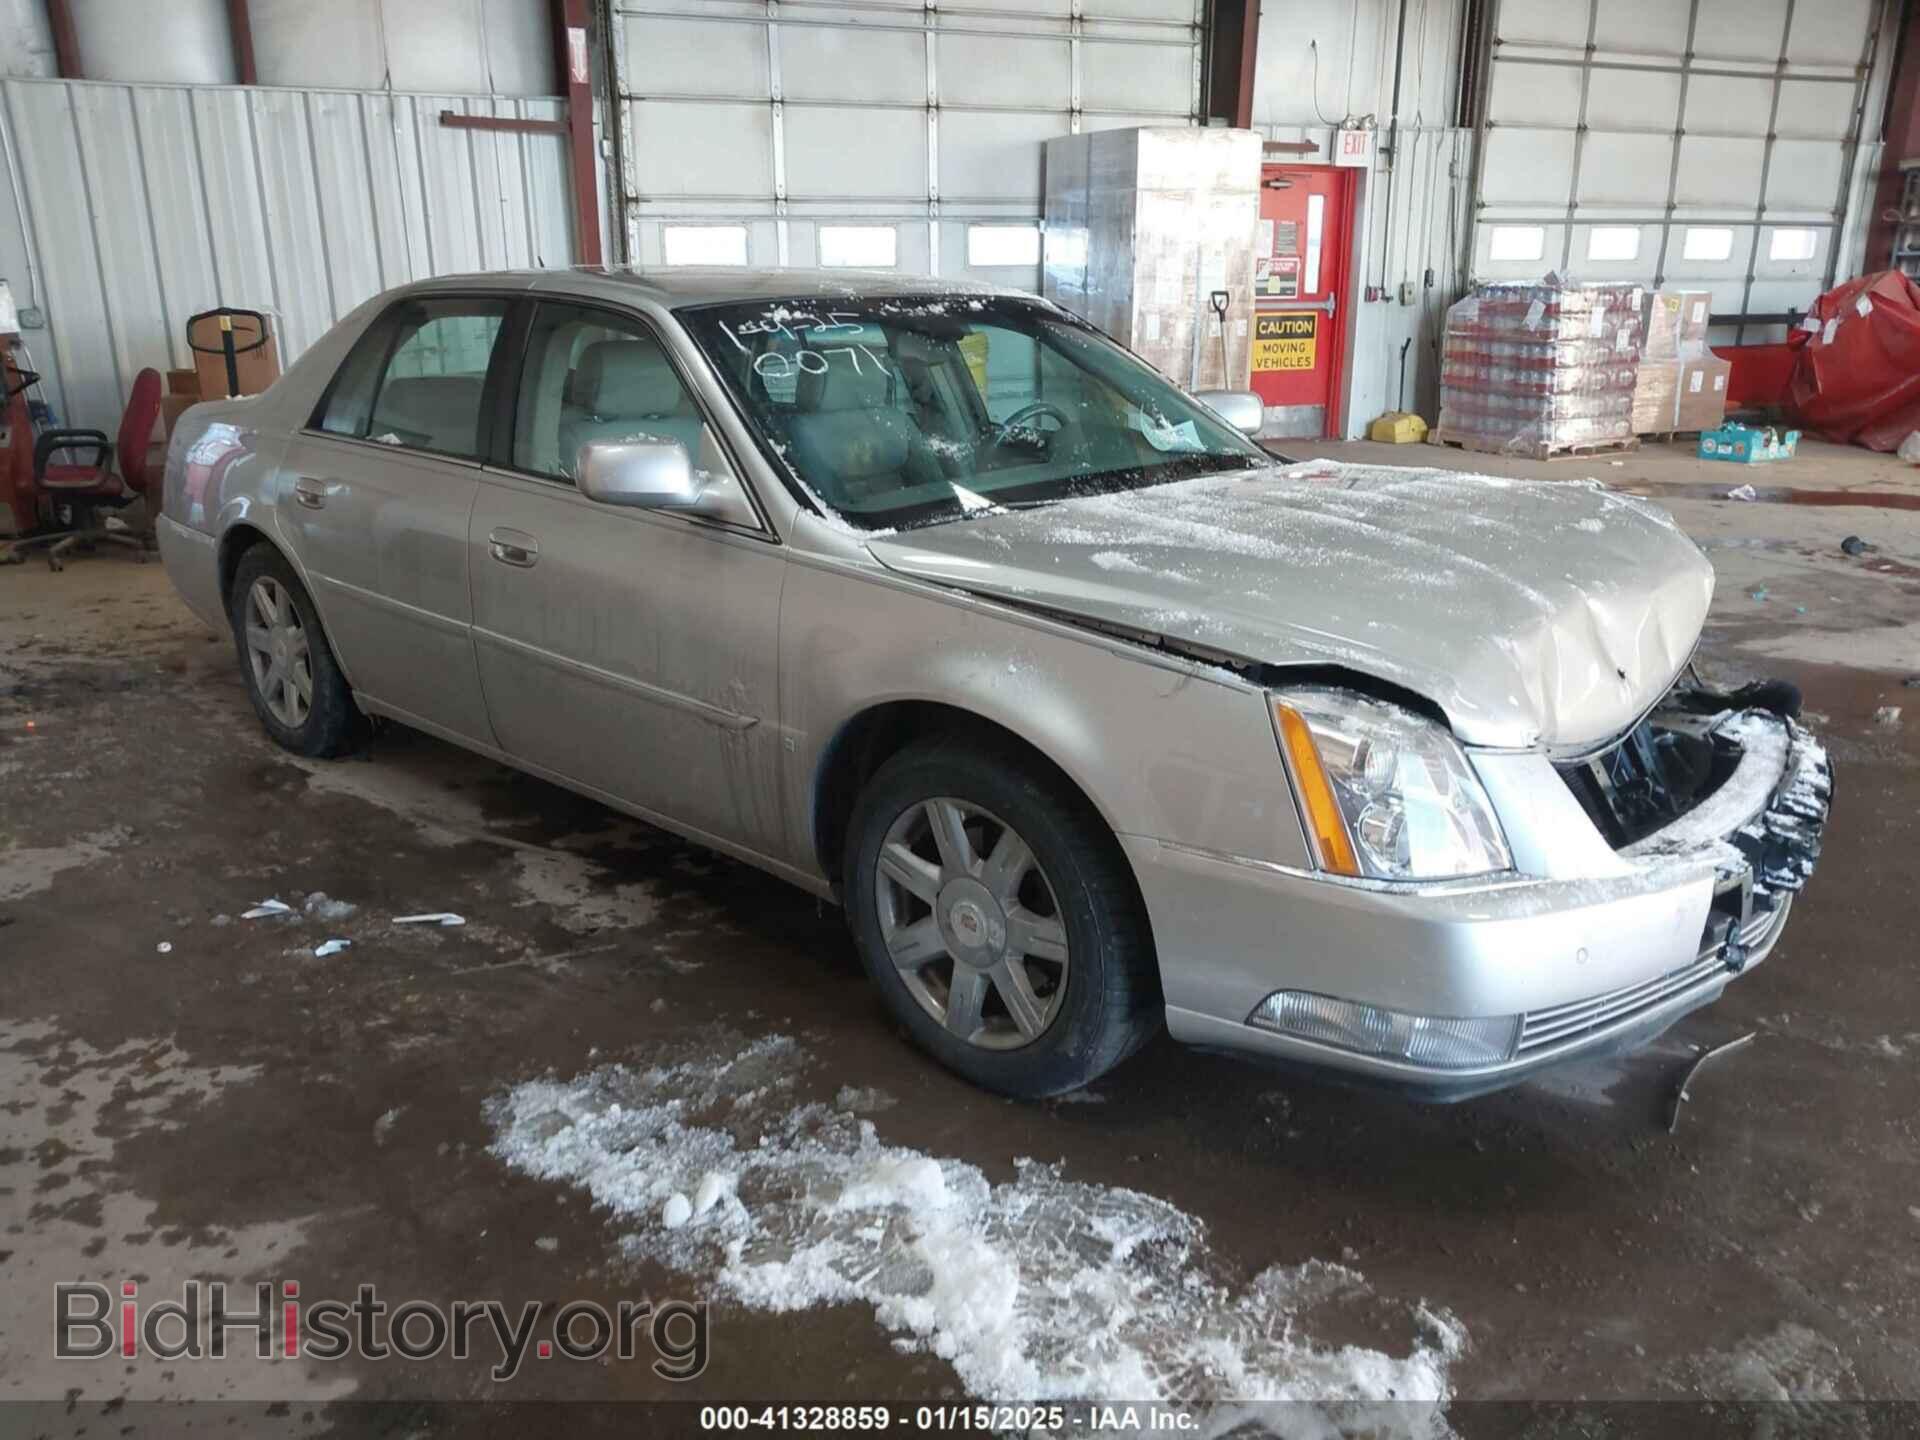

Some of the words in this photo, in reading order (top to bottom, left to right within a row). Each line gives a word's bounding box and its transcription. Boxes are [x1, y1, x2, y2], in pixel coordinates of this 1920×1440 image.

[1344, 133, 1368, 154] EXIT
[1259, 320, 1313, 335] CAUTION
[1263, 342, 1306, 354] MOVING
[1256, 356, 1311, 369] VEHICLES
